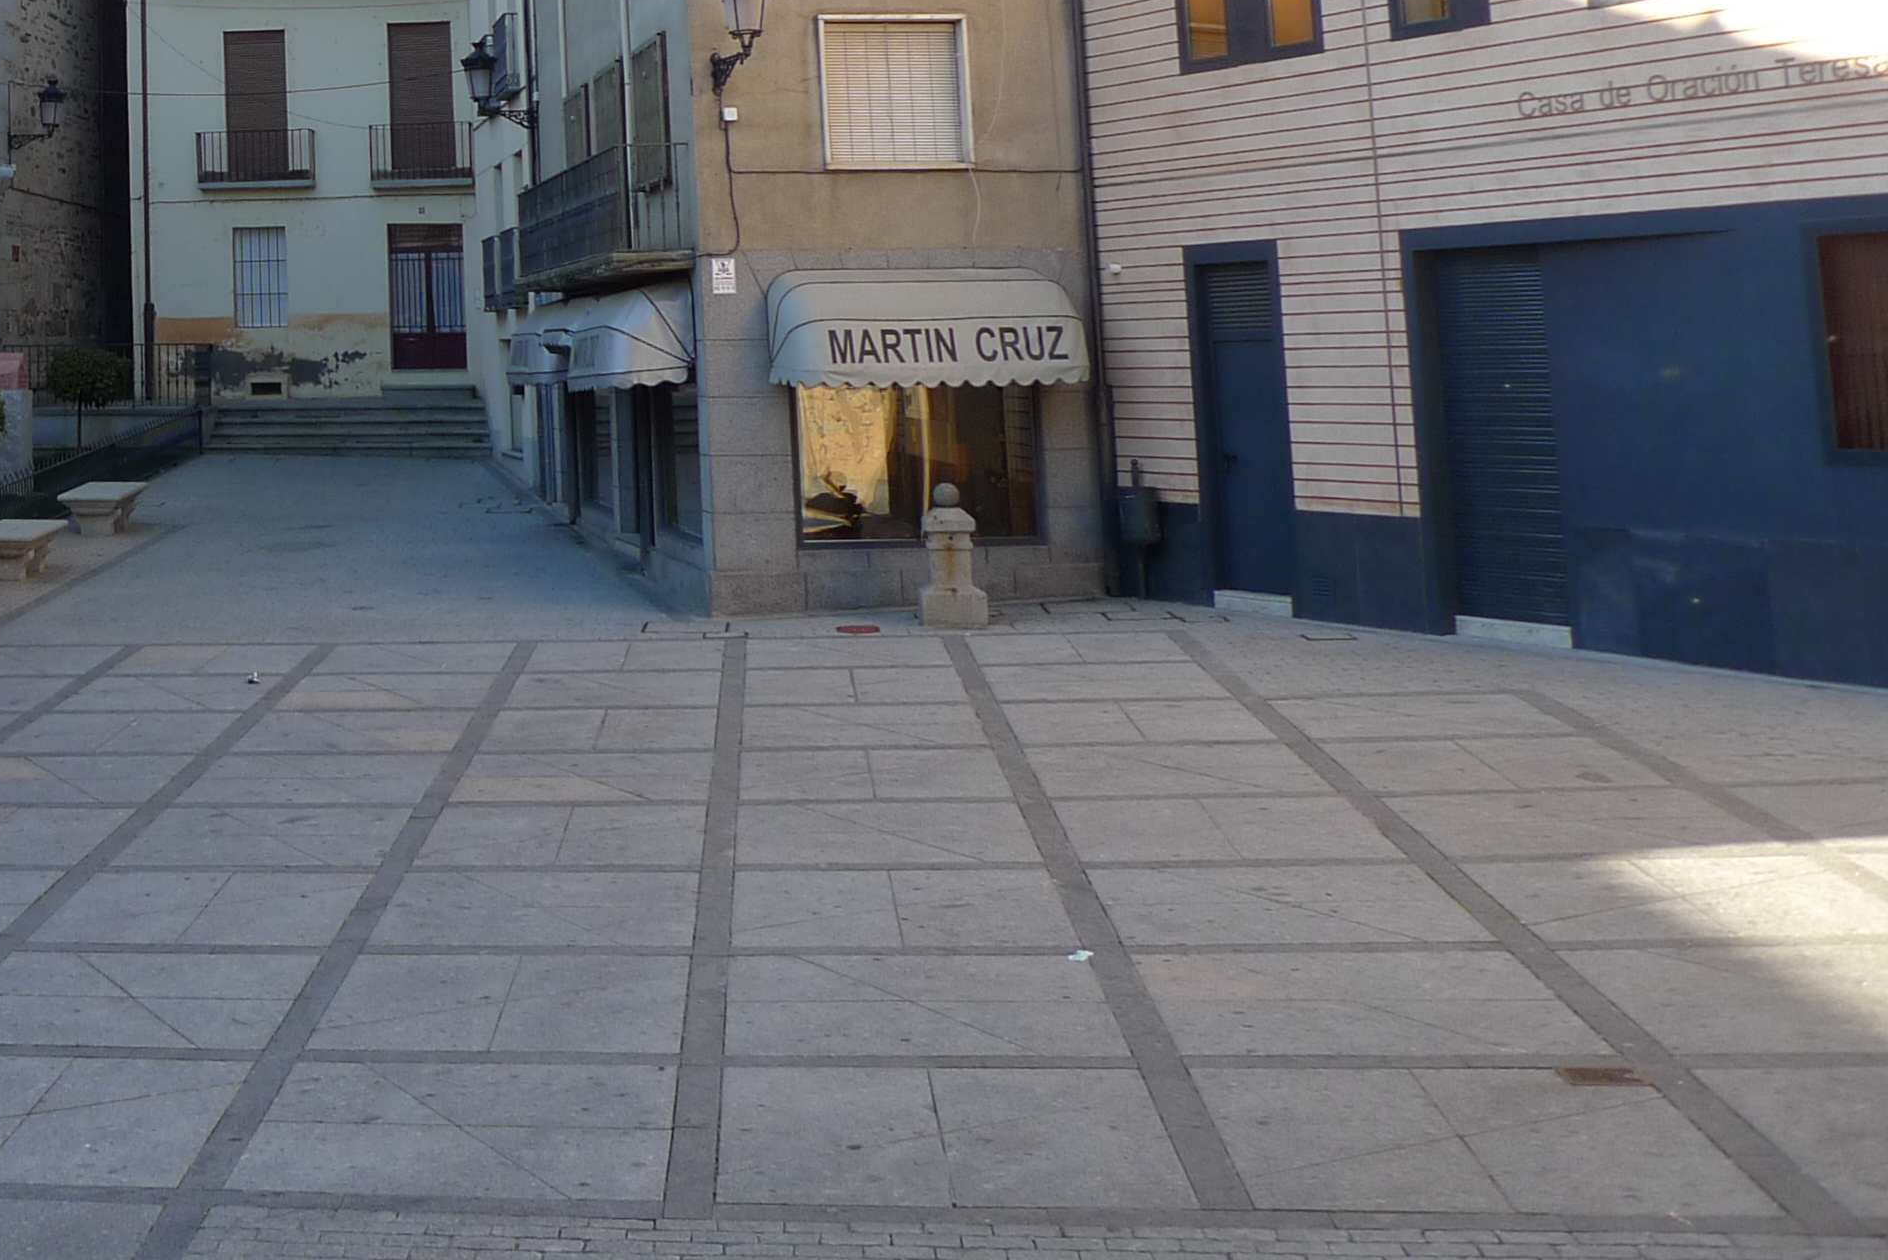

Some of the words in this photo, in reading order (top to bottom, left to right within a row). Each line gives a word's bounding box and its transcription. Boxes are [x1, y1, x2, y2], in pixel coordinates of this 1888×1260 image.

[1516, 91, 1586, 119] Casa
[1599, 81, 1632, 109] de
[1646, 64, 1761, 102] Oración
[827, 327, 959, 365] MARTIN
[975, 325, 1070, 363] CRUZ
